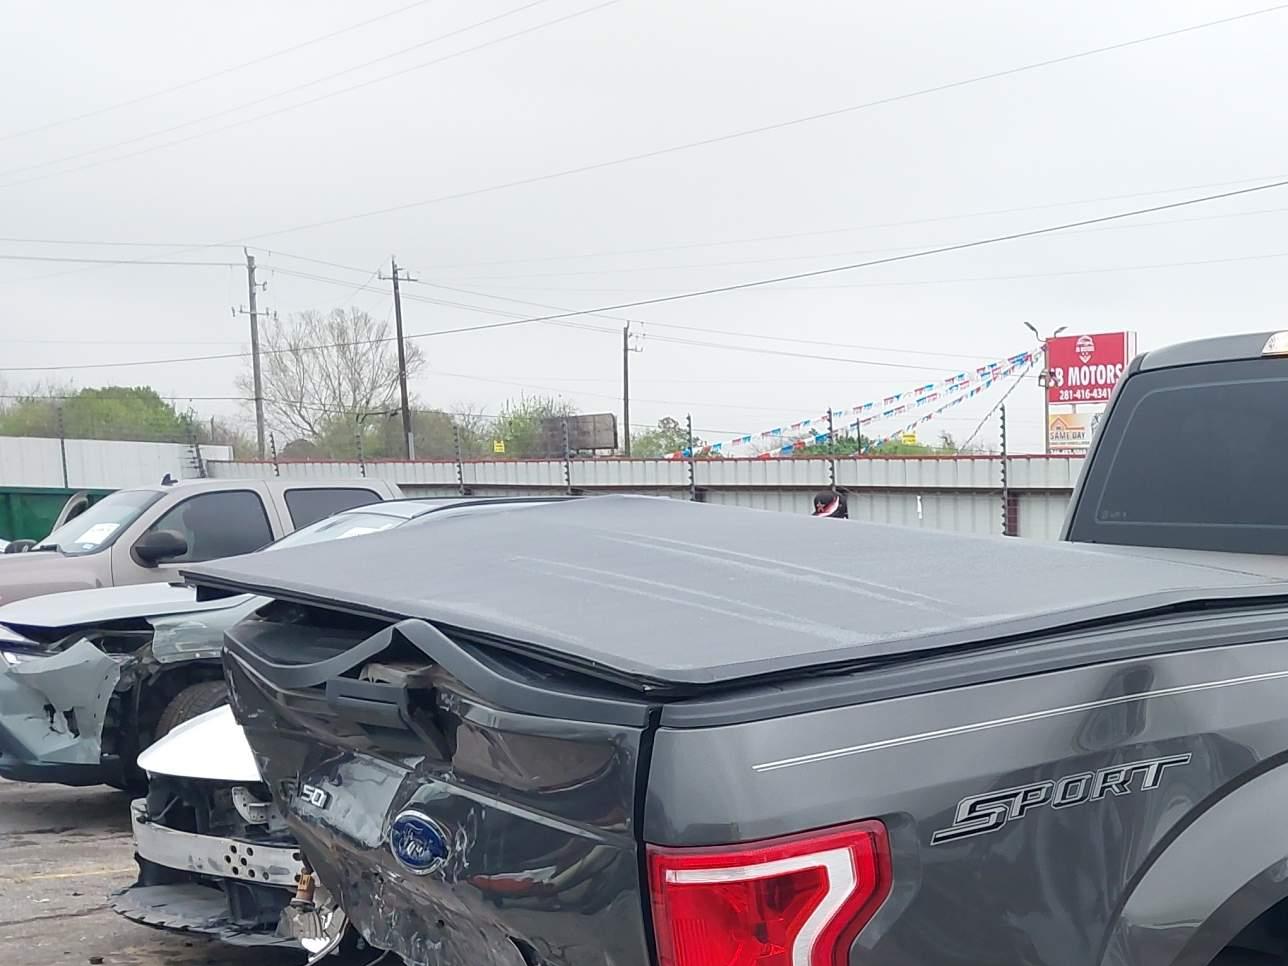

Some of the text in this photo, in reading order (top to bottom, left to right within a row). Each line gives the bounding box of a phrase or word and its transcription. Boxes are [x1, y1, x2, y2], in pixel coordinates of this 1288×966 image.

[1068, 363, 1123, 387] MOTORS
[1059, 388, 1112, 401] 281-416-4341
[930, 752, 1192, 846] SPORT
